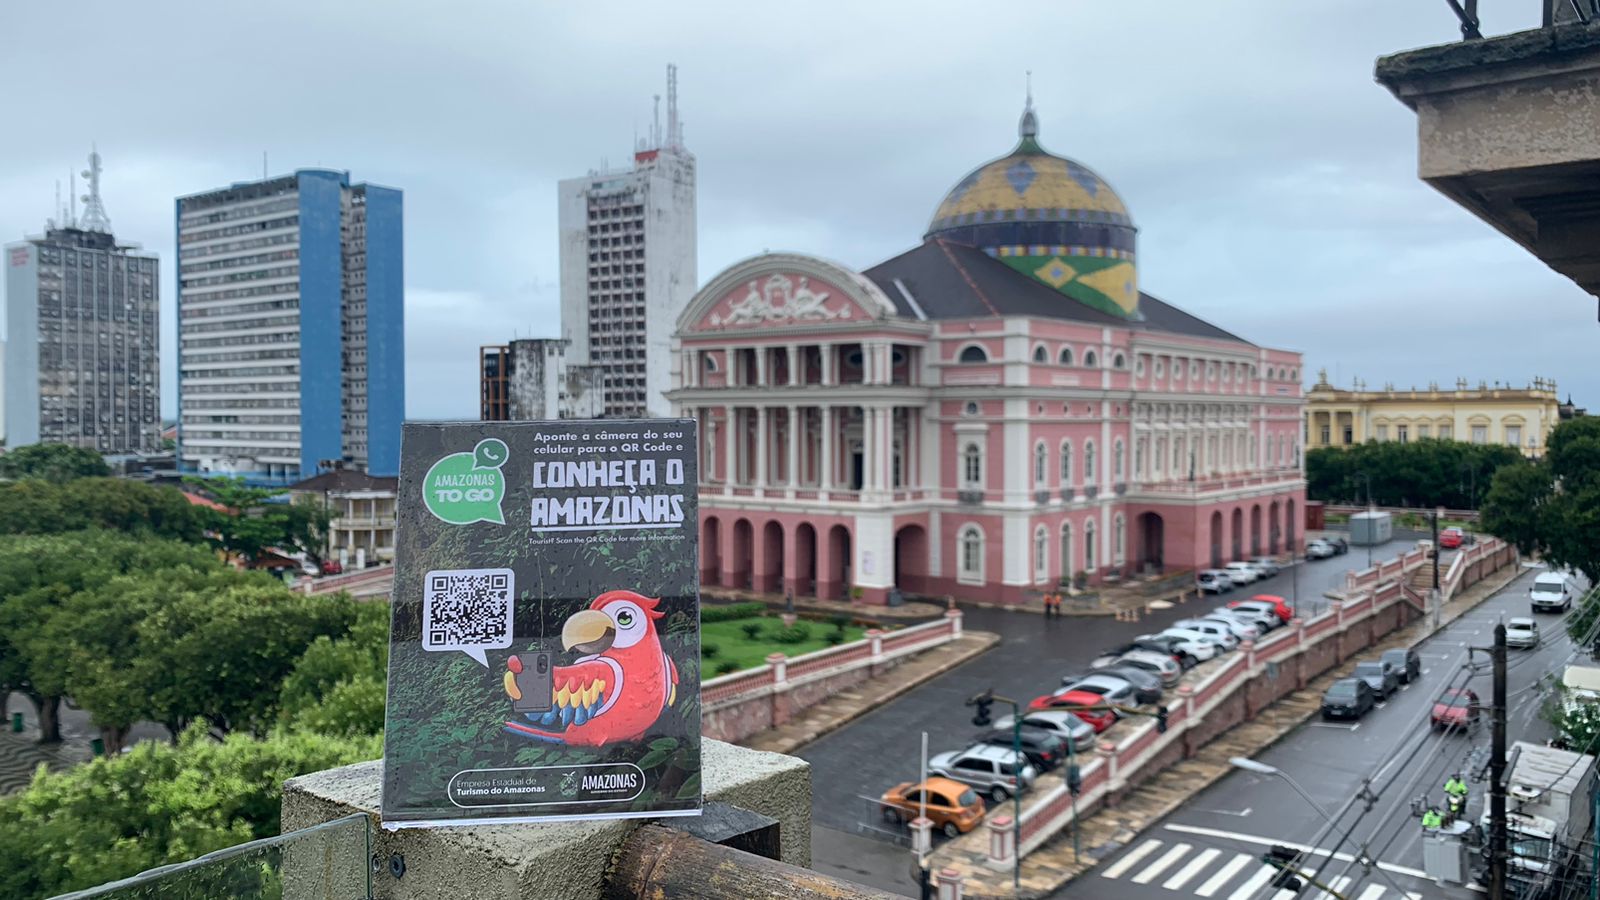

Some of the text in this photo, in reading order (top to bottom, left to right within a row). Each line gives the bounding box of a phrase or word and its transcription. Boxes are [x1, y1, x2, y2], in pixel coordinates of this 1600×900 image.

[534, 432, 578, 444] Aponte
[595, 430, 639, 440] câmera
[643, 430, 659, 439] do
[663, 431, 683, 439] seu
[534, 444, 574, 454] celular
[577, 445, 606, 455] para
[621, 443, 640, 454] QR
[644, 442, 672, 451] Code
[434, 474, 495, 487] AMAZONAS
[533, 458, 684, 493] CONHEÇA O
[435, 488, 495, 503] TO GO
[531, 494, 684, 525] AMAZONAS
[586, 536, 598, 545] QR
[600, 535, 617, 543] Code
[456, 778, 536, 791] Empresa Estadual de
[582, 773, 637, 789] AMAZONAS
[457, 784, 545, 796] Turismo do Amazonas
